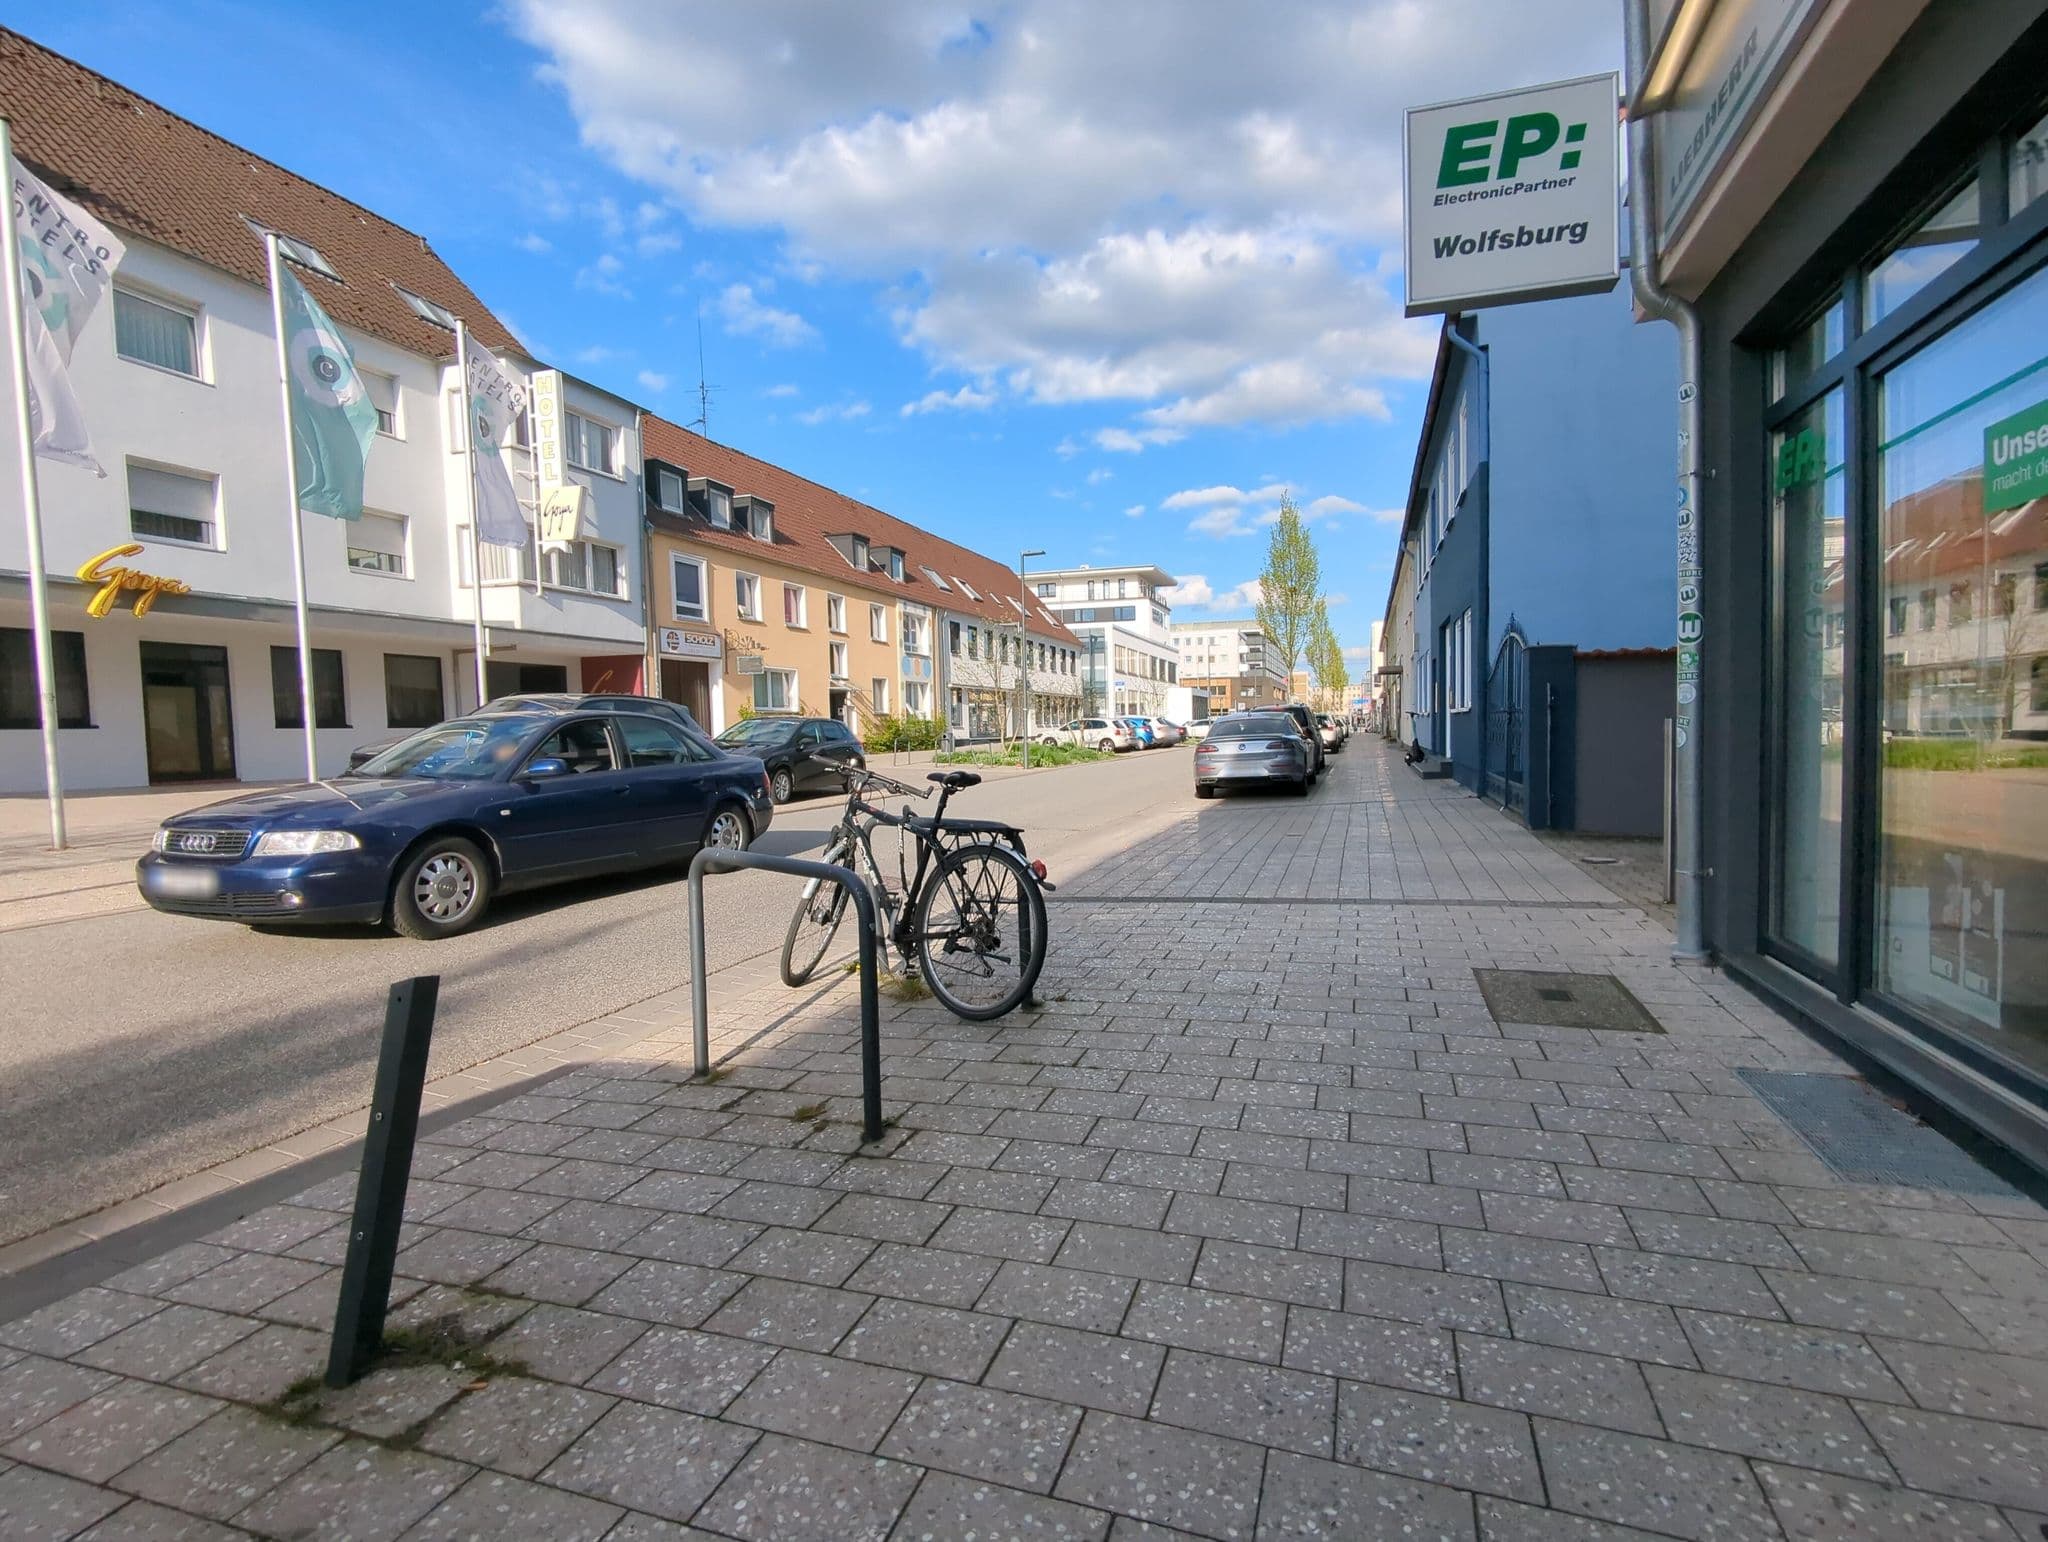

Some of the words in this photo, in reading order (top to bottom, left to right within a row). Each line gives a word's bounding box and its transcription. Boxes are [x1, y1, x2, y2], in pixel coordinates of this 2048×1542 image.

[1670, 25, 1758, 197] LIEBHERR
[1436, 112, 1588, 189] EP:
[1433, 176, 1576, 207] ElectronicPartner
[15, 179, 110, 260] ENTRO
[1433, 221, 1589, 259] Wolfsburg
[470, 356, 522, 403] ENTRO
[536, 375, 558, 481] HOTEL
[1993, 463, 2032, 492] macht
[685, 633, 715, 646] SCHOLZ
